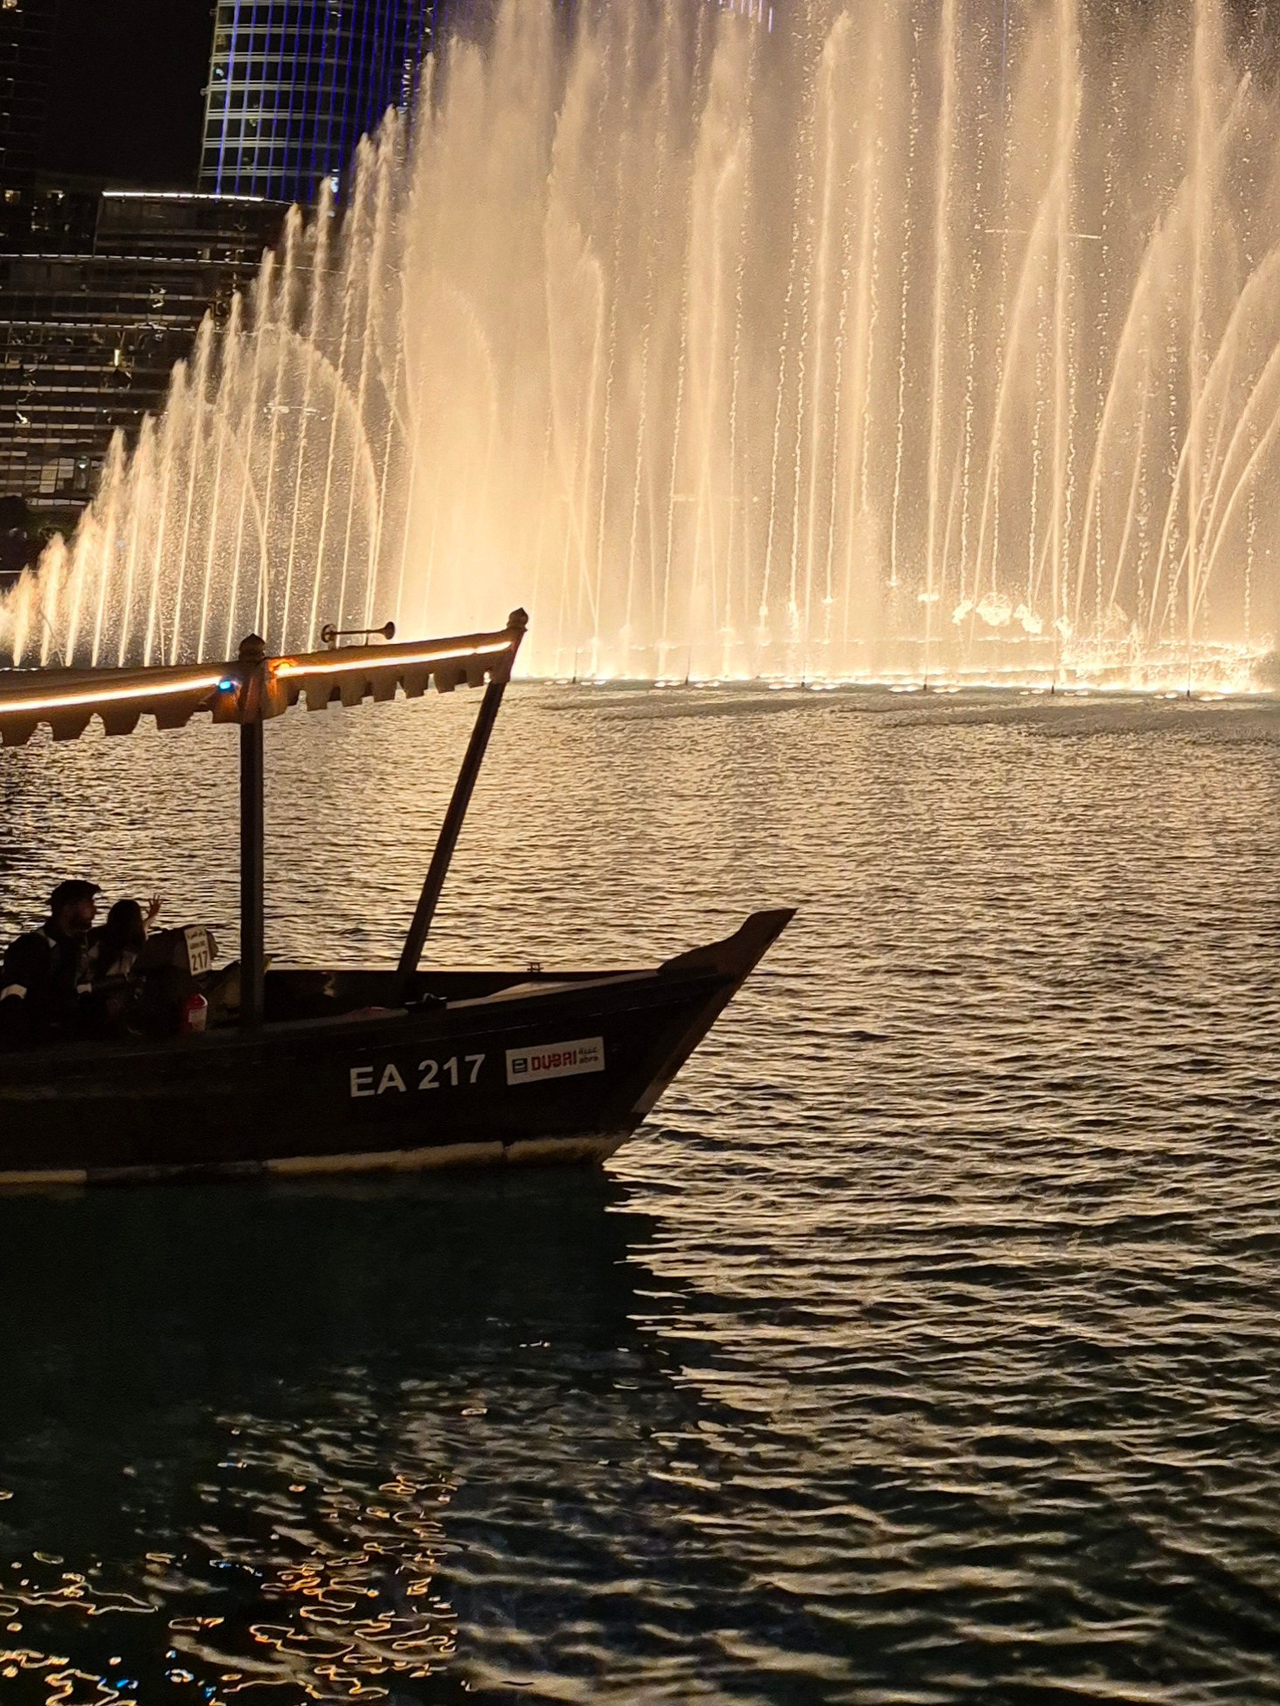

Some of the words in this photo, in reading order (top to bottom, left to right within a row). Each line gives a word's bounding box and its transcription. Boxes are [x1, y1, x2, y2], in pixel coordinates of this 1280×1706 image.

[191, 950, 208, 972] 217
[530, 1049, 577, 1071] DUBAI
[350, 1064, 407, 1097] EA
[417, 1053, 486, 1090] 217
